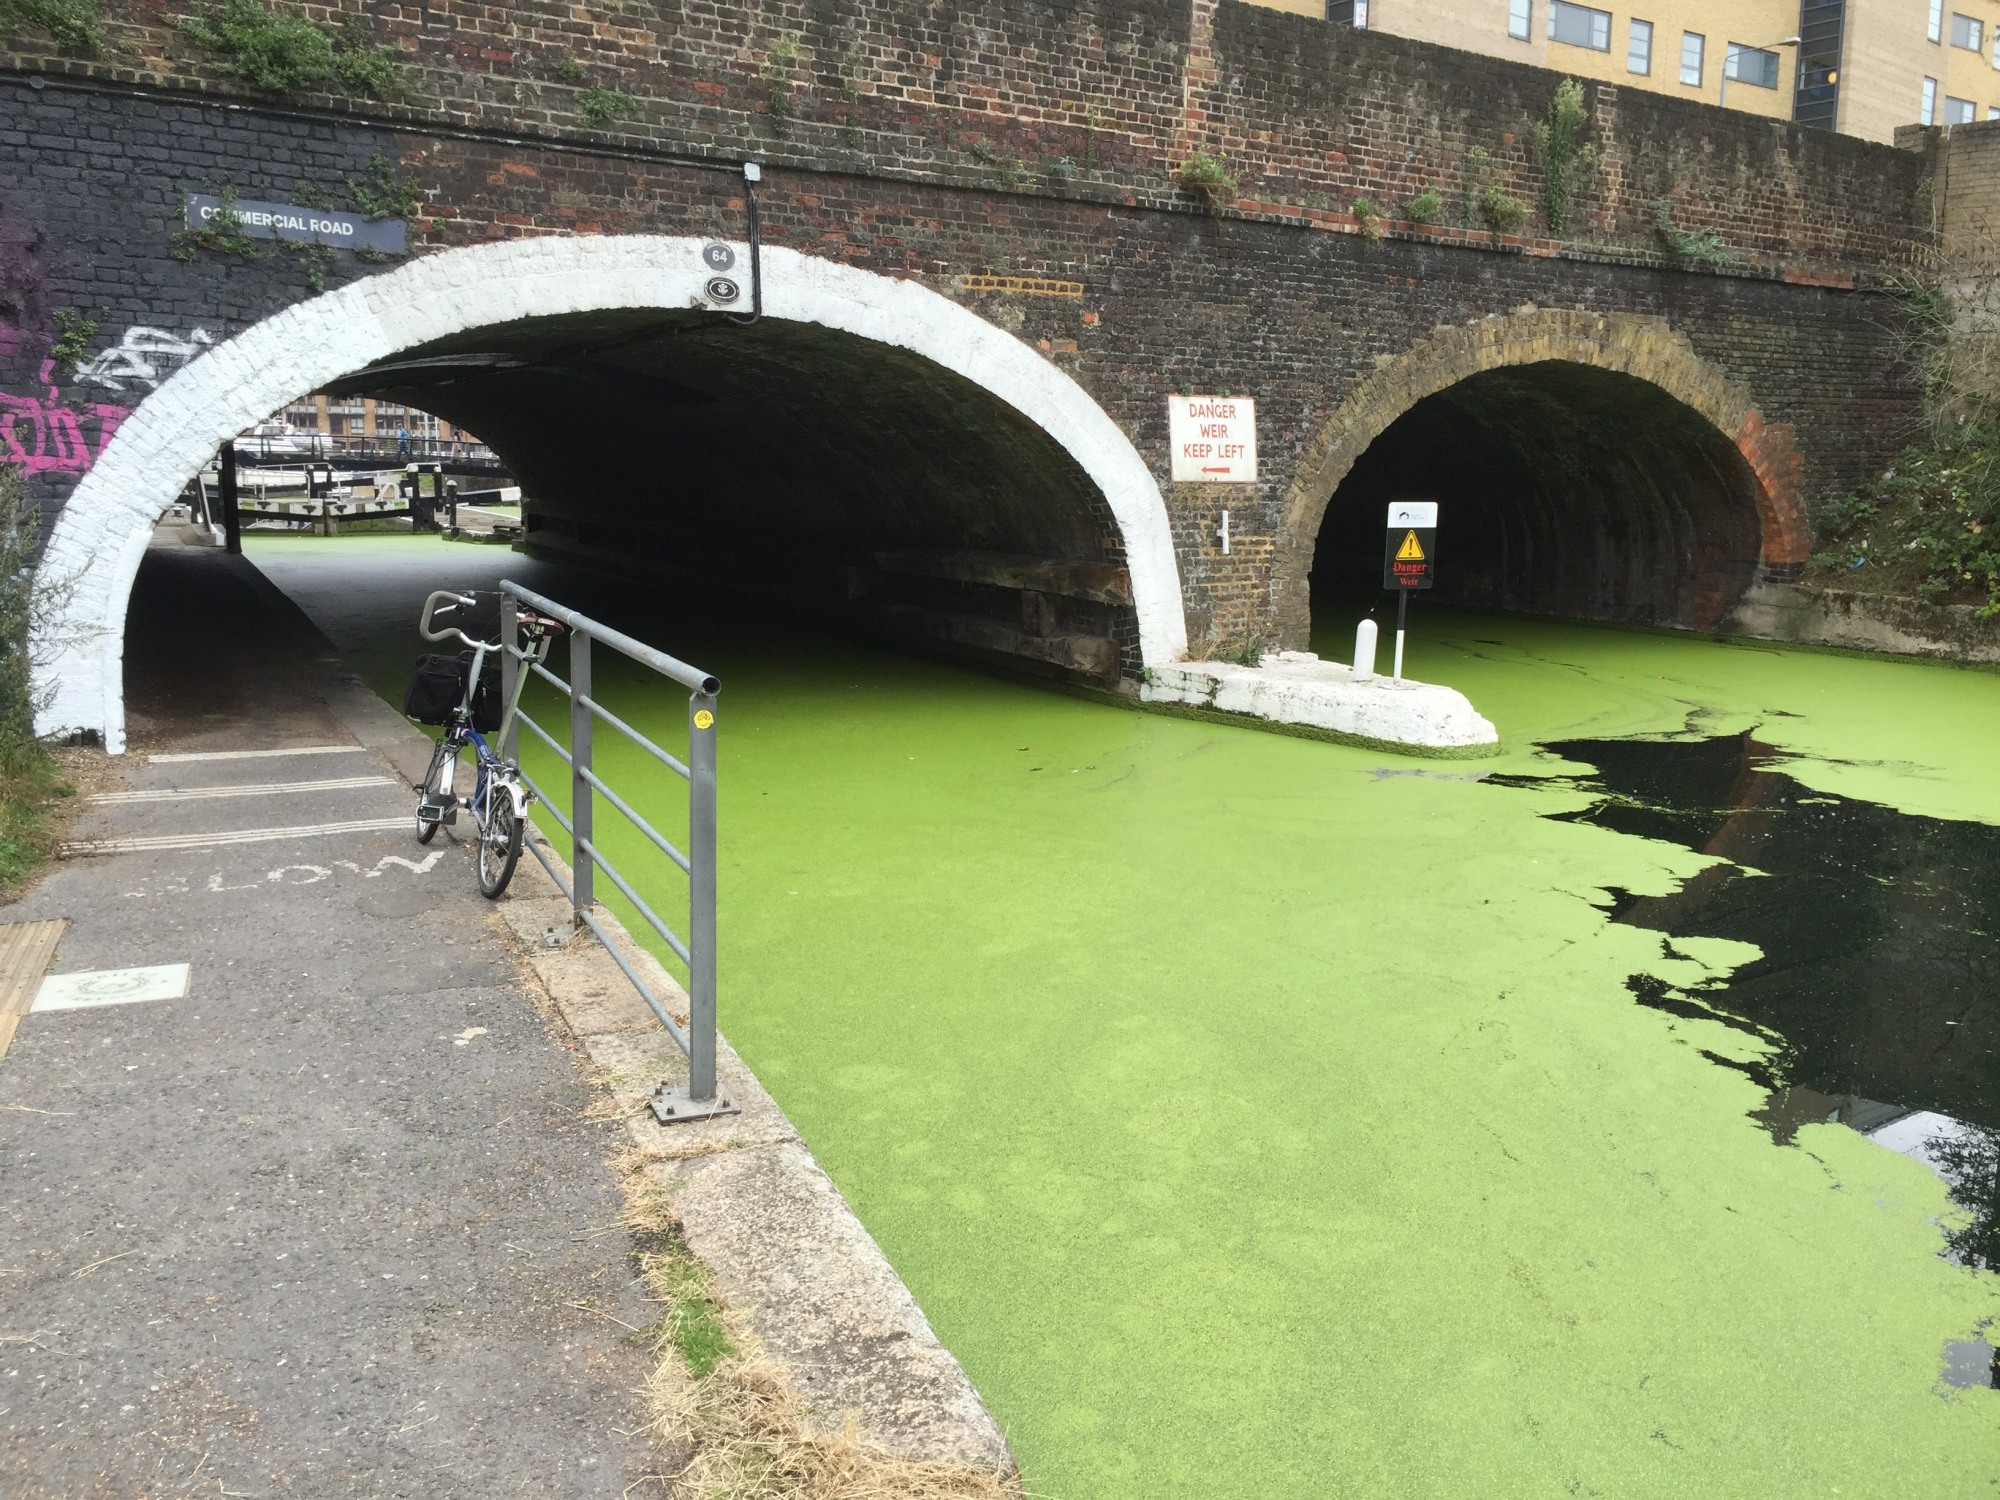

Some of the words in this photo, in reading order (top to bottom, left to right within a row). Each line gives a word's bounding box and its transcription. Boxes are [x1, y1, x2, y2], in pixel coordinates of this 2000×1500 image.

[309, 218, 354, 236] ROAD
[712, 250, 727, 262] 64
[1189, 403, 1236, 419] DANGER
[1200, 424, 1228, 438] WEIR
[1183, 443, 1213, 458] KEEP
[1218, 444, 1245, 459] LEFT
[1392, 562, 1427, 574] Danger
[1400, 577, 1419, 586] Weir
